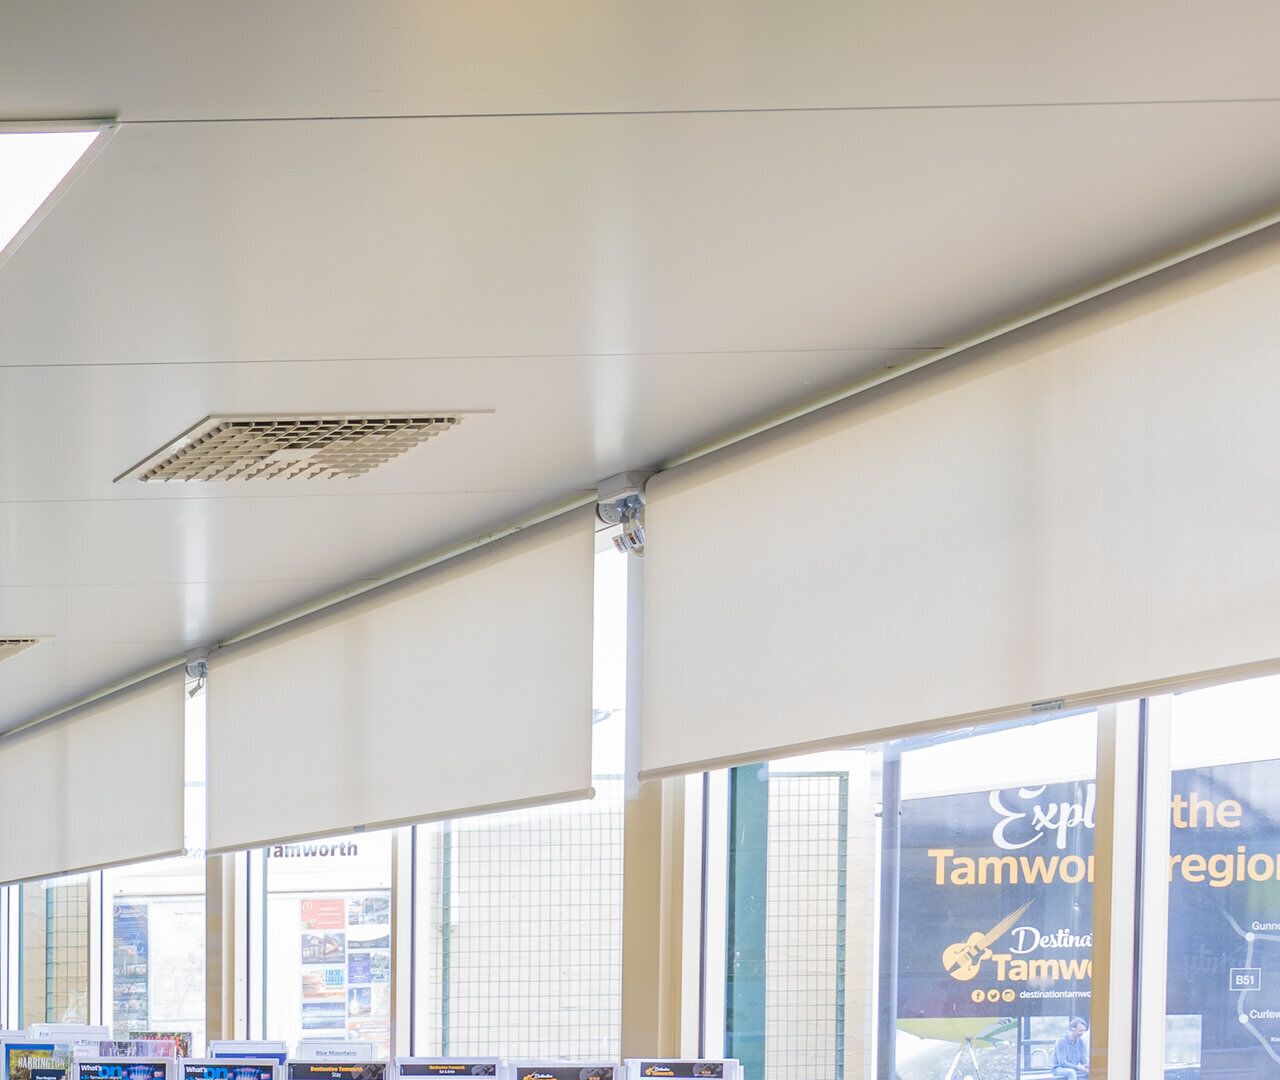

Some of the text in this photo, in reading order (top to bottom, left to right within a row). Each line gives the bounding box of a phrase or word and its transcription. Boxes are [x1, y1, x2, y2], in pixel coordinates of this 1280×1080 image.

[989, 783, 1242, 850] Expl the
[927, 849, 1094, 885] Tamwo
[1235, 975, 1255, 985] B51
